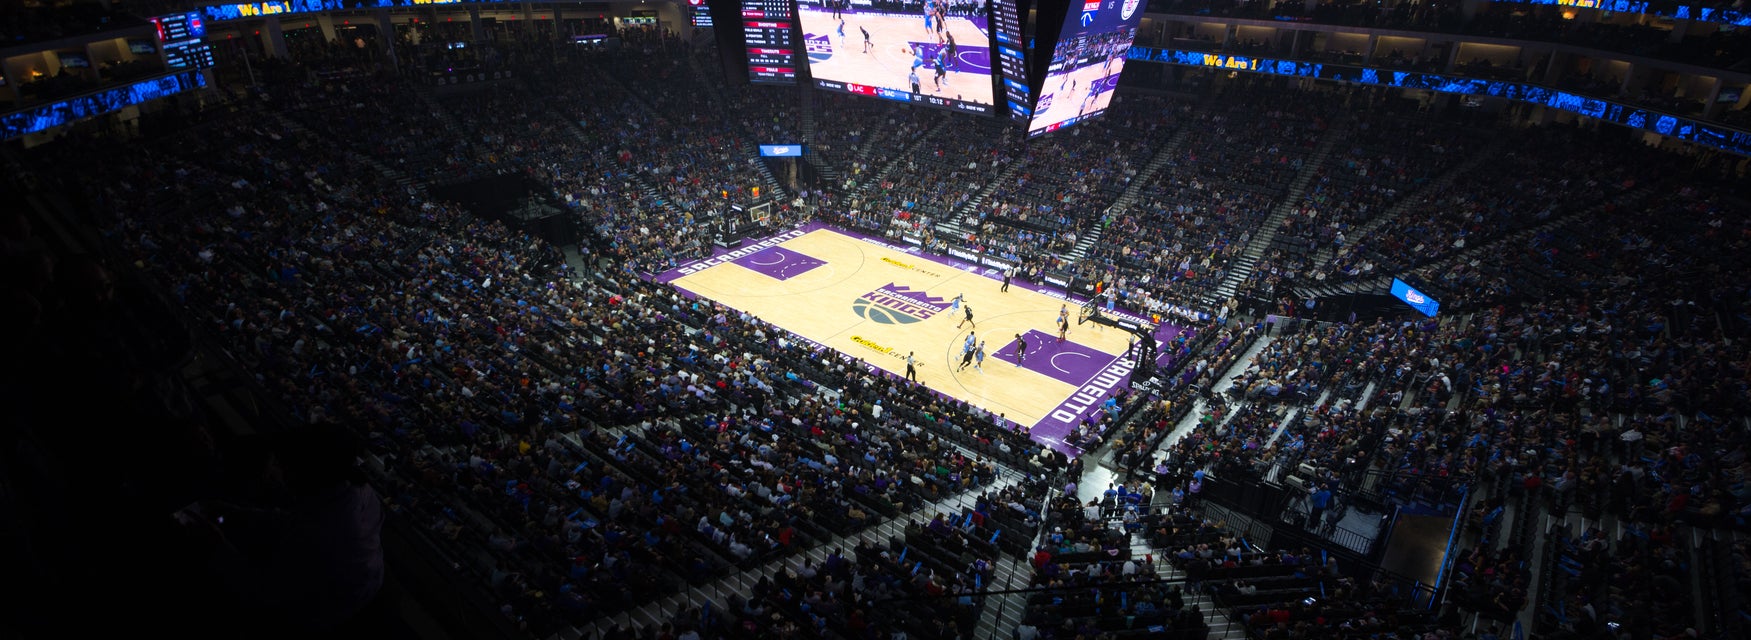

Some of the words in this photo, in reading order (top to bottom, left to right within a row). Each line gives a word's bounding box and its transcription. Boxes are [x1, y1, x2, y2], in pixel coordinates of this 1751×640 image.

[237, 3, 260, 17] We
[261, 2, 283, 15] Are
[284, 0, 292, 13] 1
[1203, 54, 1223, 67] We
[1225, 56, 1248, 70] Are
[1250, 58, 1258, 71] 1
[853, 85, 864, 93] LAC
[884, 89, 895, 97] SAC
[929, 97, 944, 105] 10:12
[678, 229, 806, 276] SACRAMENTO
[861, 291, 937, 320] KINGS
[876, 288, 942, 312] SACRAMENTO
[888, 350, 926, 368] CENER
[1131, 381, 1161, 397] SPALDNG
